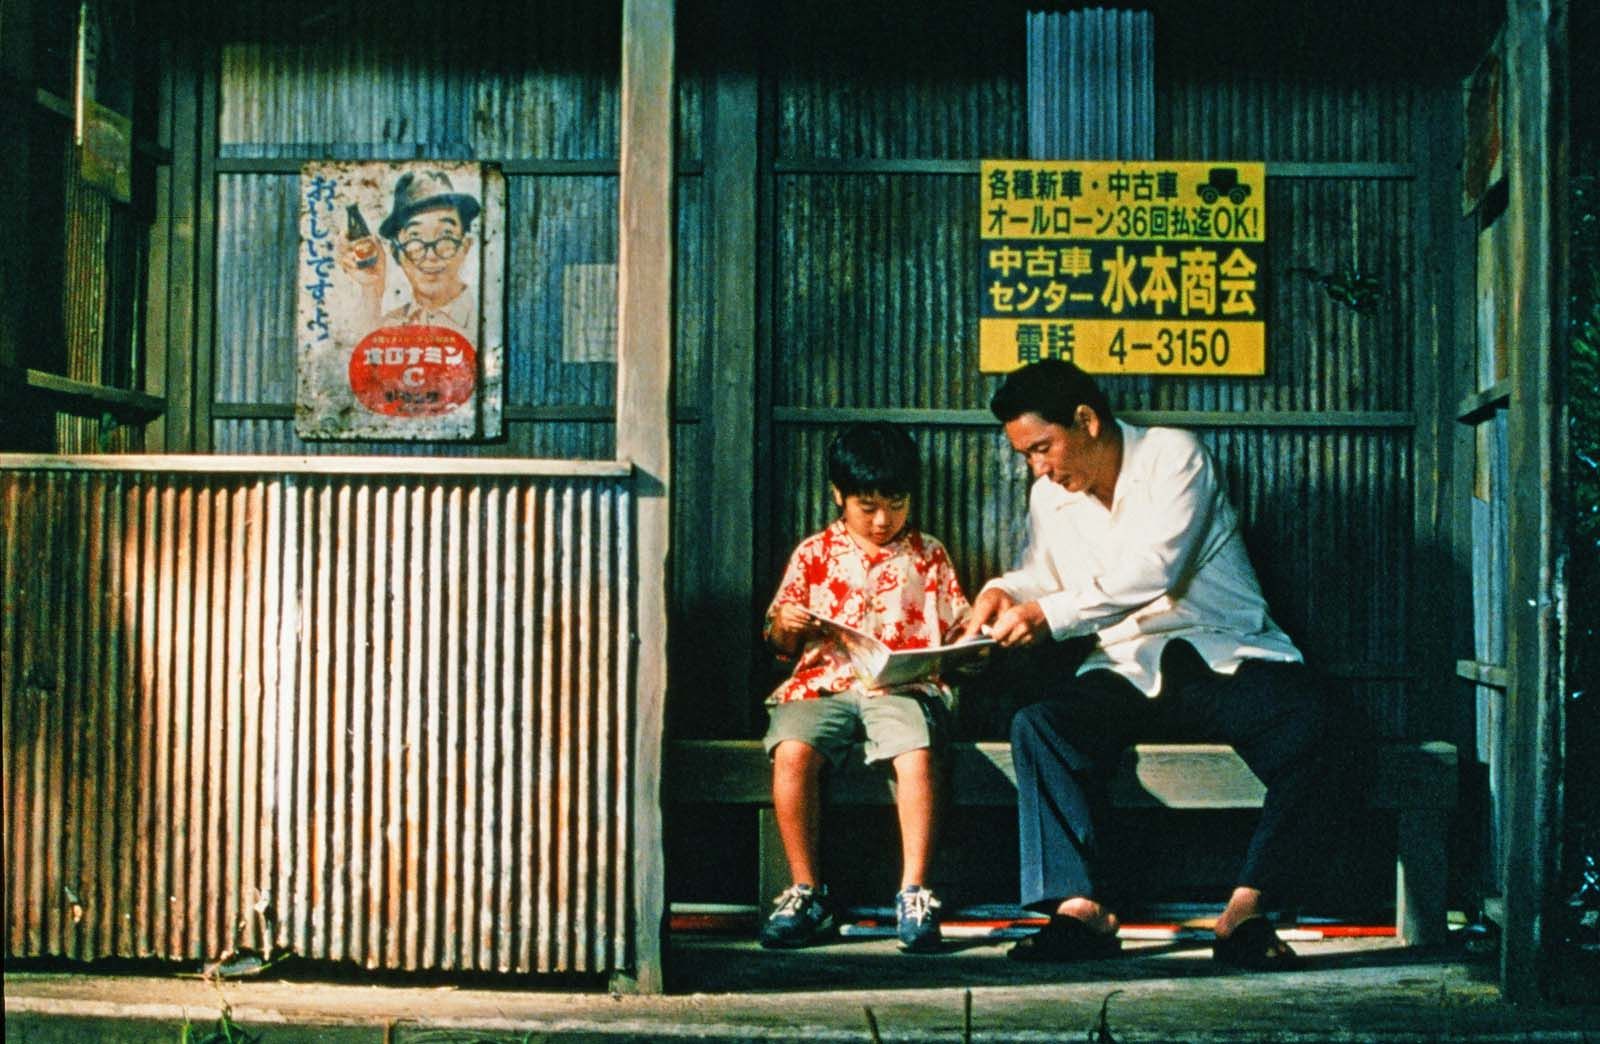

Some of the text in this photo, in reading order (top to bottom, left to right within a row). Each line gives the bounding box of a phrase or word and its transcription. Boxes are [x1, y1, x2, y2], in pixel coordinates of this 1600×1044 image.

[988, 247, 1093, 277] 中古車
[1101, 245, 1257, 316] 水本商会
[988, 281, 1094, 312] センター
[1016, 324, 1075, 363] 電話
[403, 367, 425, 387] C
